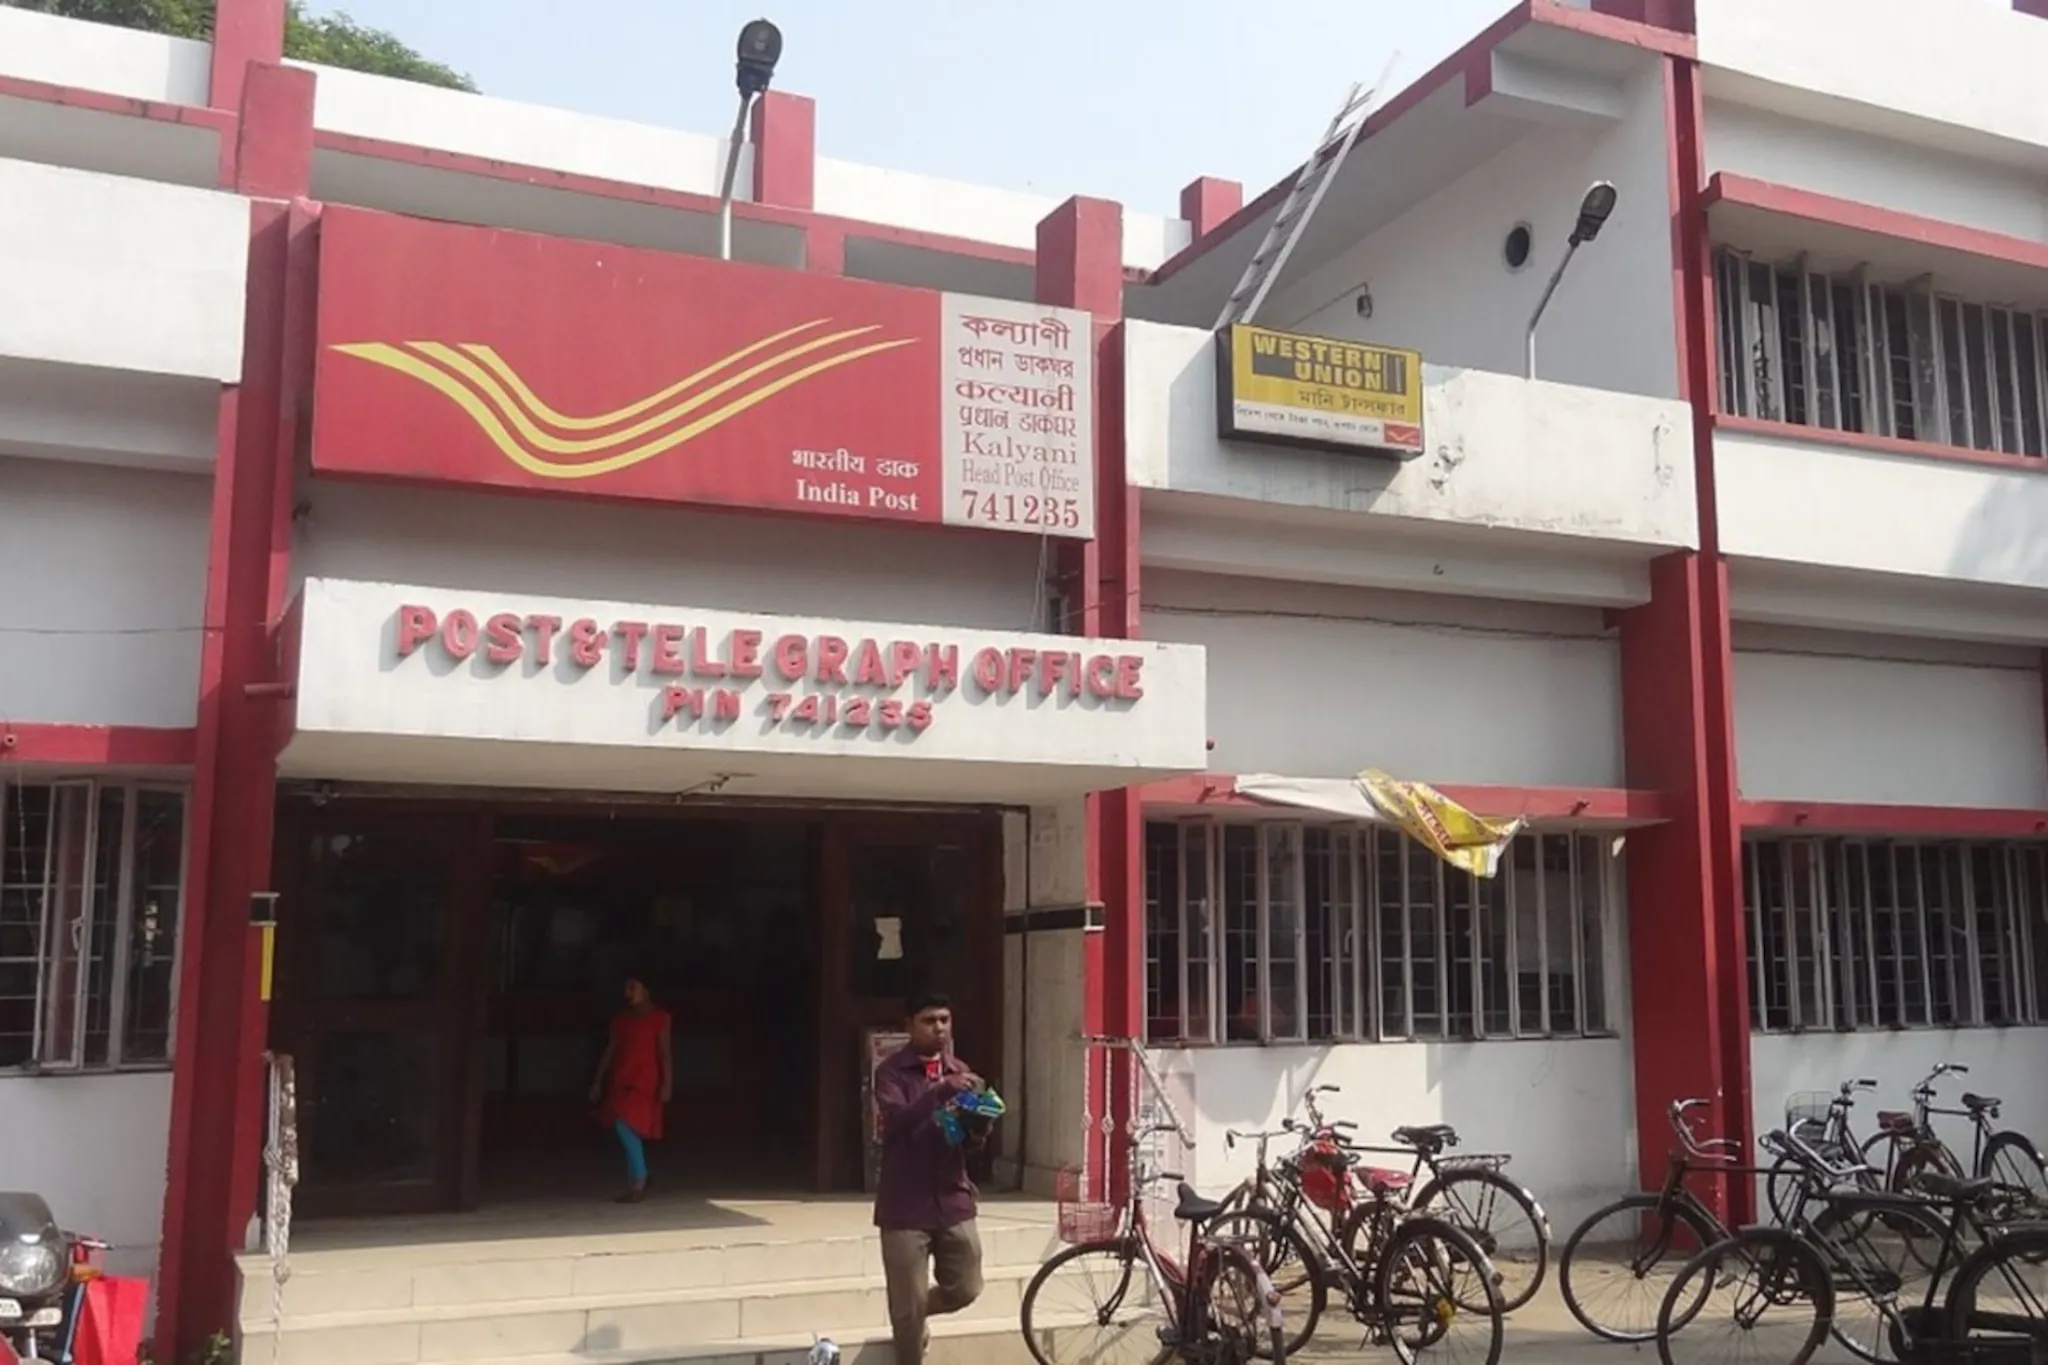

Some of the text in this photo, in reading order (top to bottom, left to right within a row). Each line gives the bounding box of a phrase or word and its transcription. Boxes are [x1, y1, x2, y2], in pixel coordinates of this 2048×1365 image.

[958, 314, 1072, 350] কল্যাণী
[958, 345, 1074, 379] প্রধান ডাকঘর
[1253, 333, 1382, 371] WESTERN
[1294, 361, 1382, 391] UNION
[958, 404, 1078, 438] प्रधान डाकघर
[791, 448, 921, 479] भारतीय डाक
[961, 430, 1078, 464] Kalyani
[961, 458, 1080, 493] Head Post Office
[796, 478, 920, 512] India Post
[961, 489, 1080, 529] 741235
[972, 645, 1145, 700] OFFICE
[661, 683, 934, 732] PIN 741235
